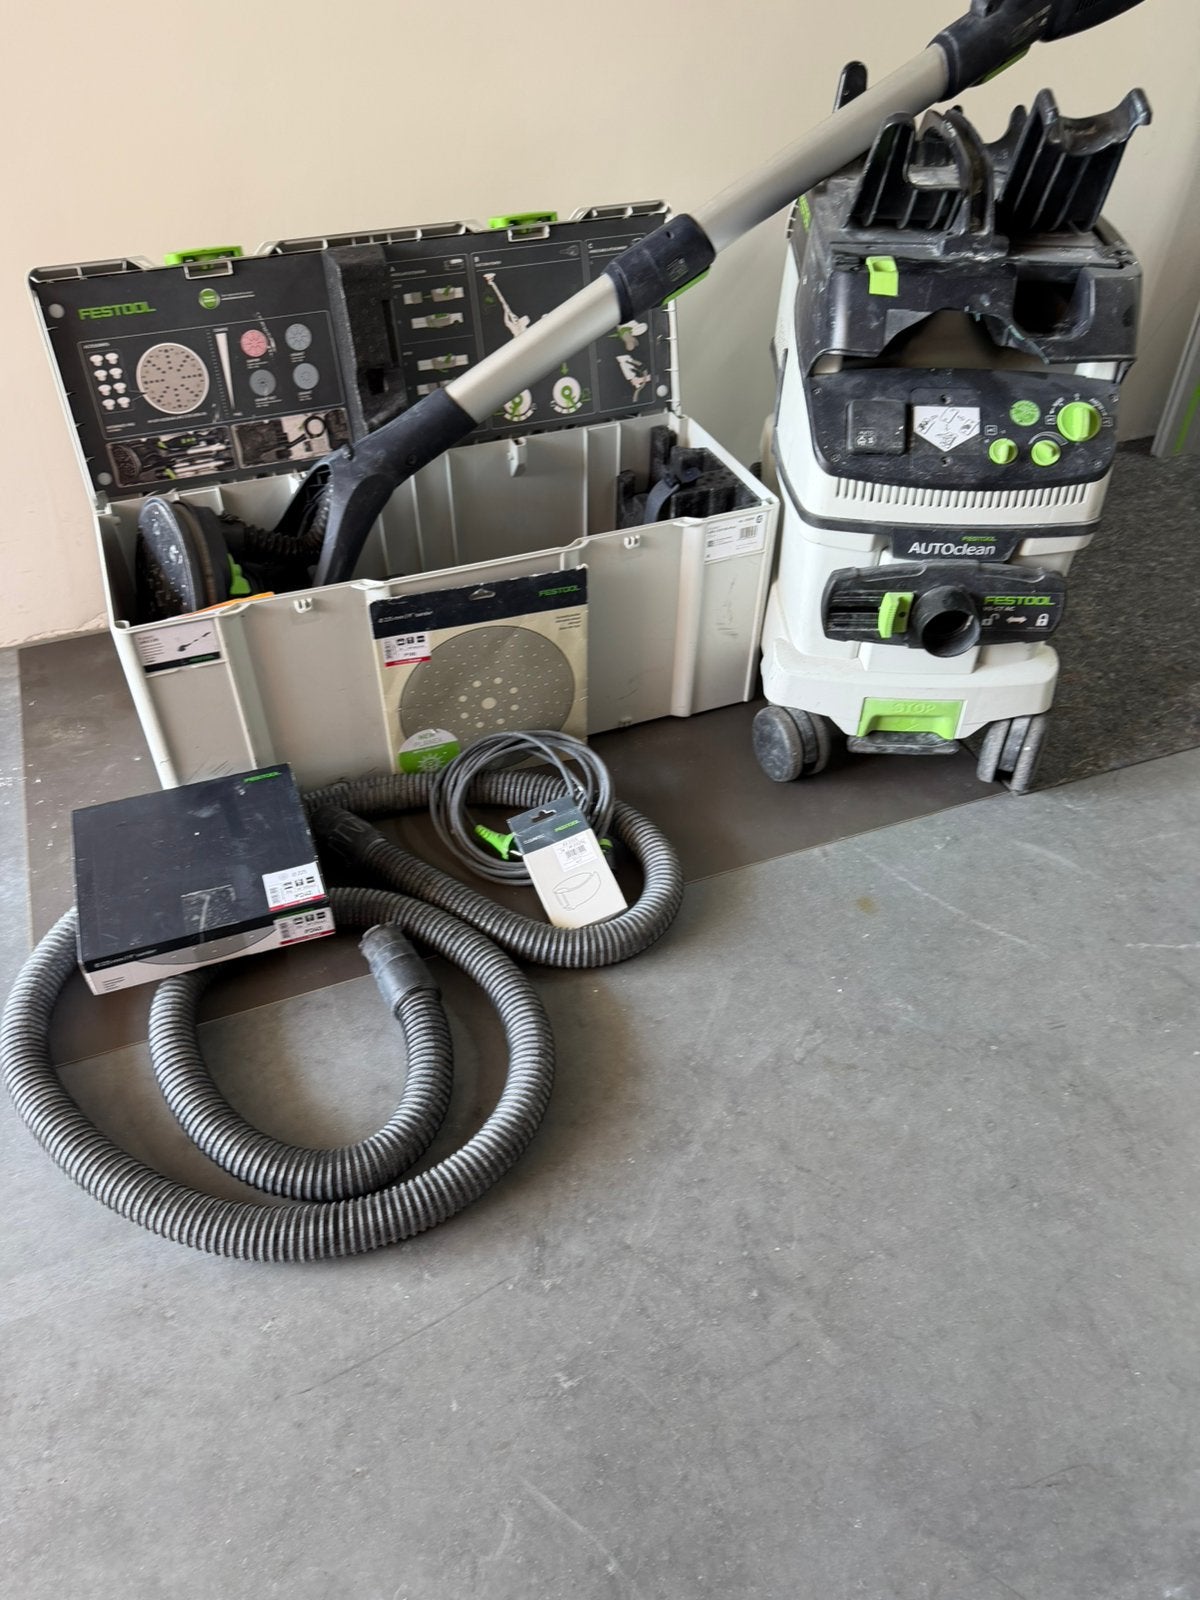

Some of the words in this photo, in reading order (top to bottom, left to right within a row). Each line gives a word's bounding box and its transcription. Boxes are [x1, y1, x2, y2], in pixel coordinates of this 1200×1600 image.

[78, 301, 157, 320] FESTOOL
[908, 542, 996, 556] AUTOclean
[984, 596, 1056, 606] FESTOOL
[892, 702, 937, 714] STOP
